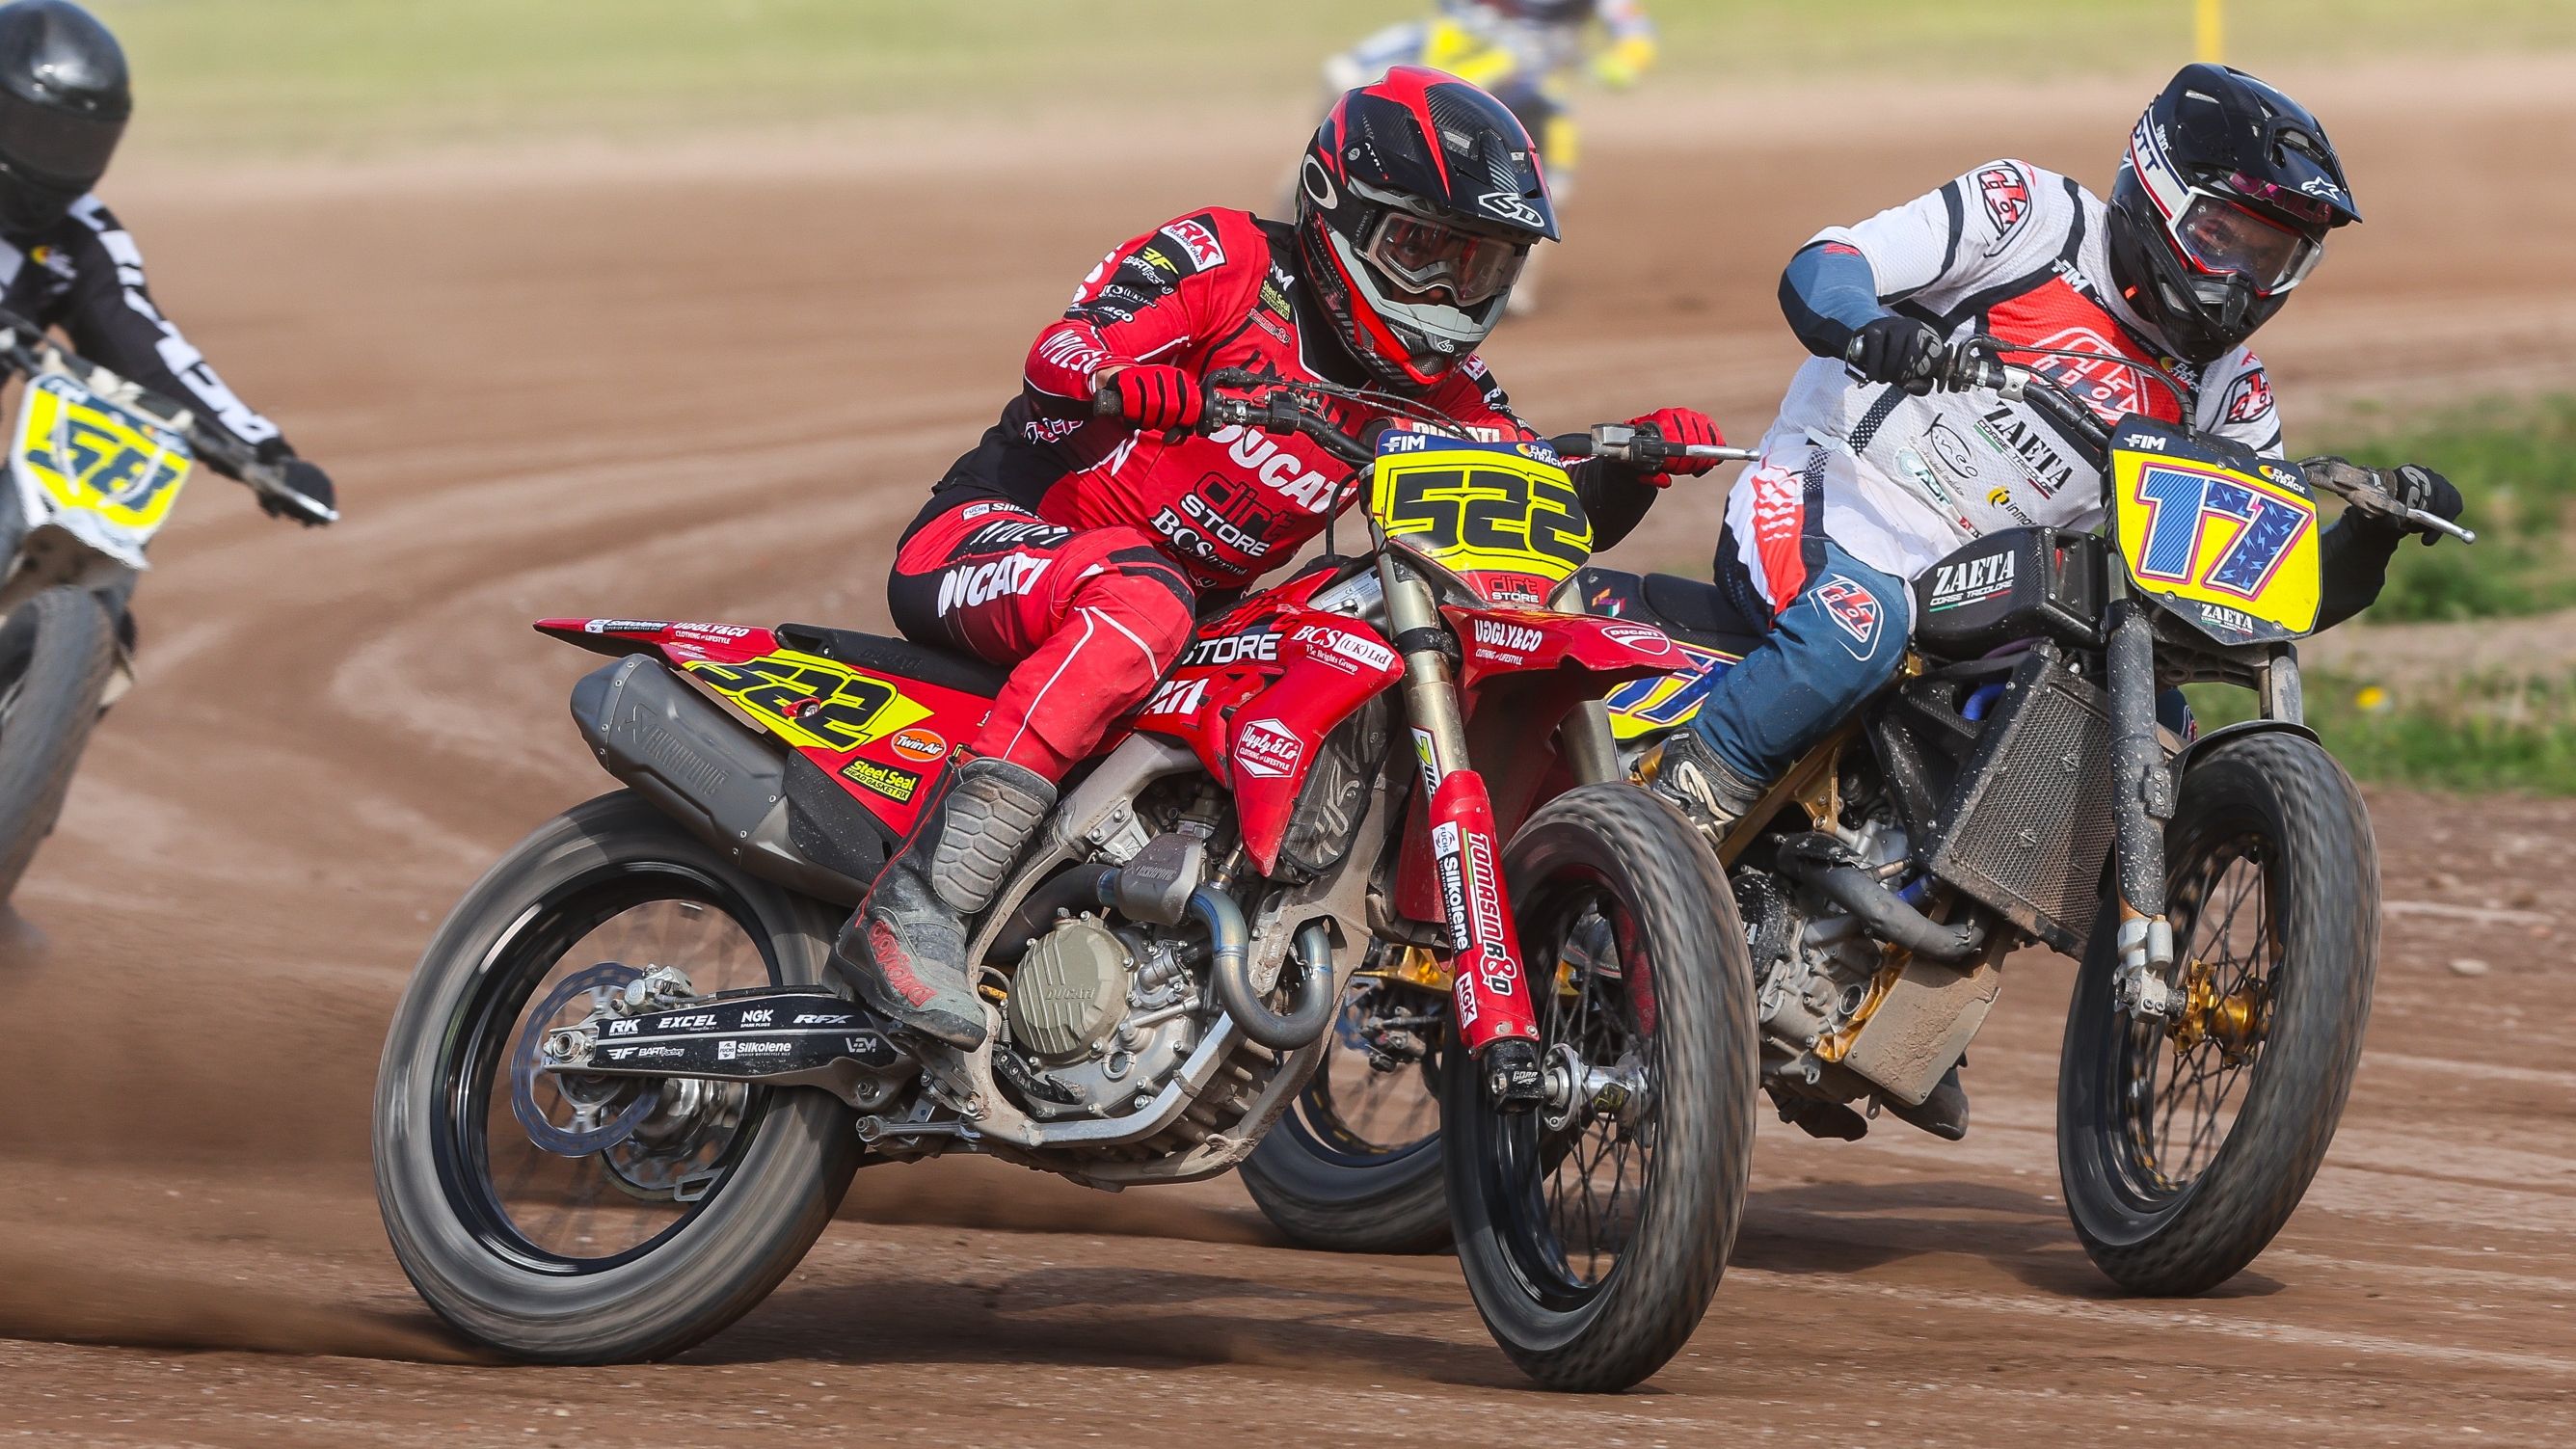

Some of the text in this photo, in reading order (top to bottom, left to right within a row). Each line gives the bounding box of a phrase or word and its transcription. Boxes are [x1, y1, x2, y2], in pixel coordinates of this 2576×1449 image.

[1173, 220, 1220, 263] RK
[2051, 257, 2091, 293] FIM
[1381, 435, 1427, 452] FIM
[1530, 444, 1553, 457] FLAT
[1976, 419, 2010, 451] CORSE
[1983, 400, 2074, 492] ZAETA
[2124, 433, 2167, 451] FIM
[1528, 452, 1564, 469] TRACK
[2273, 468, 2297, 482] FLAT
[2270, 474, 2306, 495] TRACK
[1181, 493, 1271, 557] STORE
[1388, 467, 1593, 570] 522
[2136, 465, 2311, 599] 17
[937, 551, 1053, 618] DUCATI
[1932, 550, 2015, 597] ZAETA
[1491, 591, 1540, 604] STORE
[2201, 603, 2254, 631] ZAETA
[1290, 625, 1389, 665] BCS (UK) Ltd
[1610, 629, 1659, 638] DUCATI
[1317, 649, 1338, 664] Brights
[1338, 657, 1358, 673] Group
[689, 657, 872, 753] 522
[896, 735, 944, 755] Twin Air
[845, 767, 909, 800] HEAD GASKET FIX
[850, 760, 917, 792] Steel Seal
[1443, 856, 1468, 951] Silkolene
[1468, 832, 1517, 997] TOMASIN R&D
[1044, 987, 1095, 1000] DUCATI
[1459, 977, 1476, 1021] NGK
[608, 1008, 855, 1033] RK EXCEL NGK RFX
[737, 1042, 792, 1053] Silkolene
